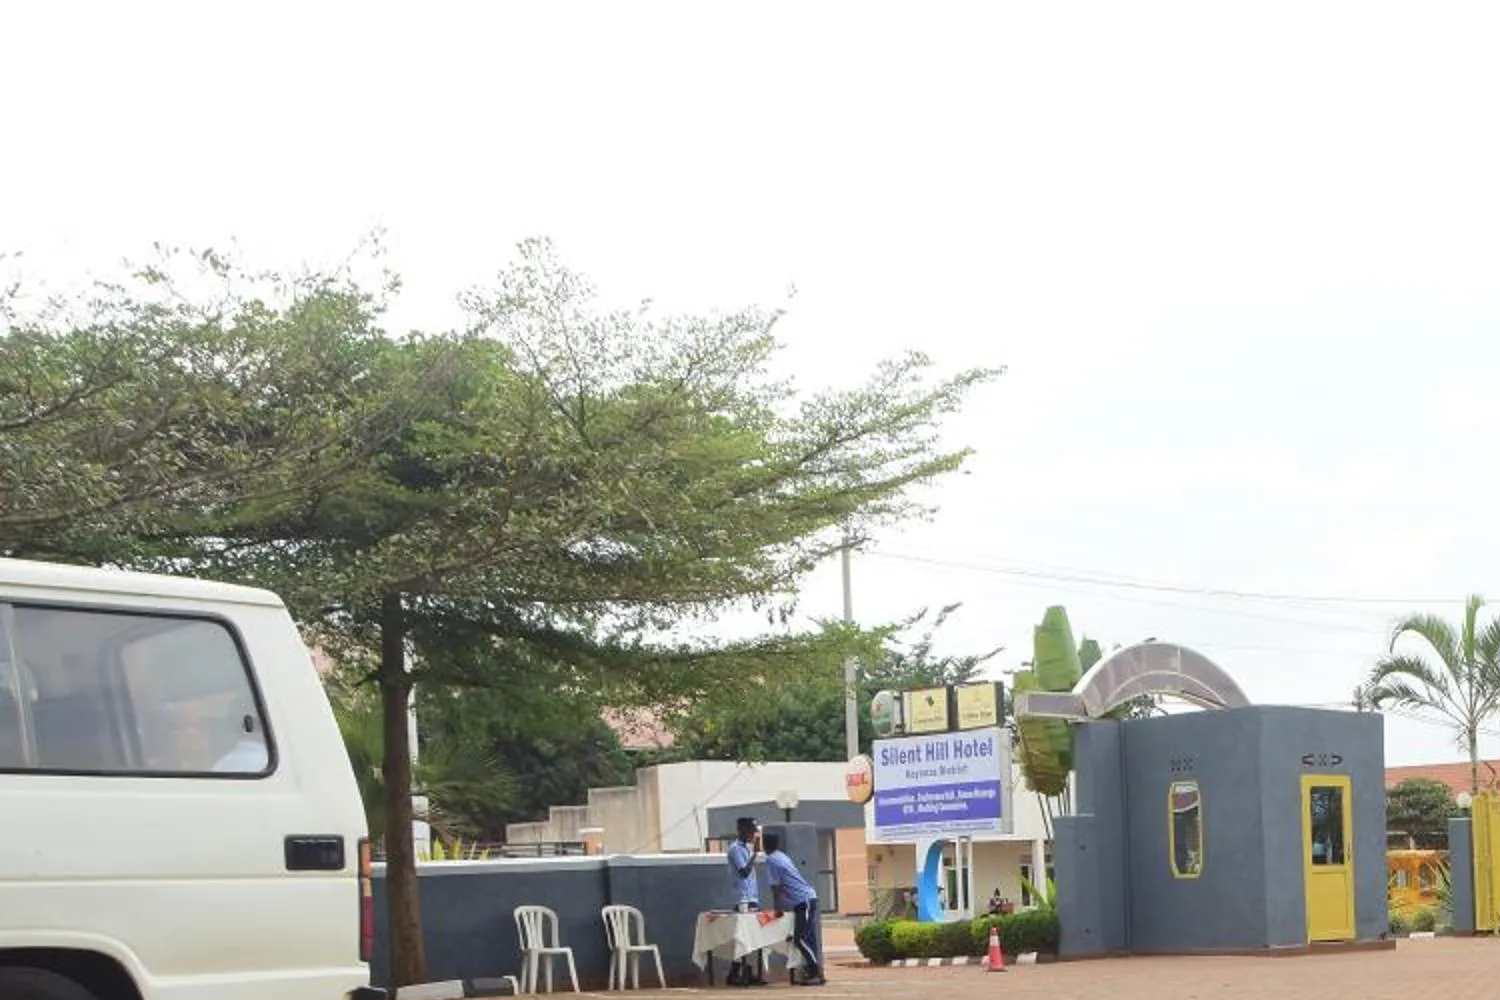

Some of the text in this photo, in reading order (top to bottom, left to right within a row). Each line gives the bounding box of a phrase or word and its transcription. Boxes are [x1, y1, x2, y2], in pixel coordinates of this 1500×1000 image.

[881, 738, 992, 766] Silent Hill Hotel
